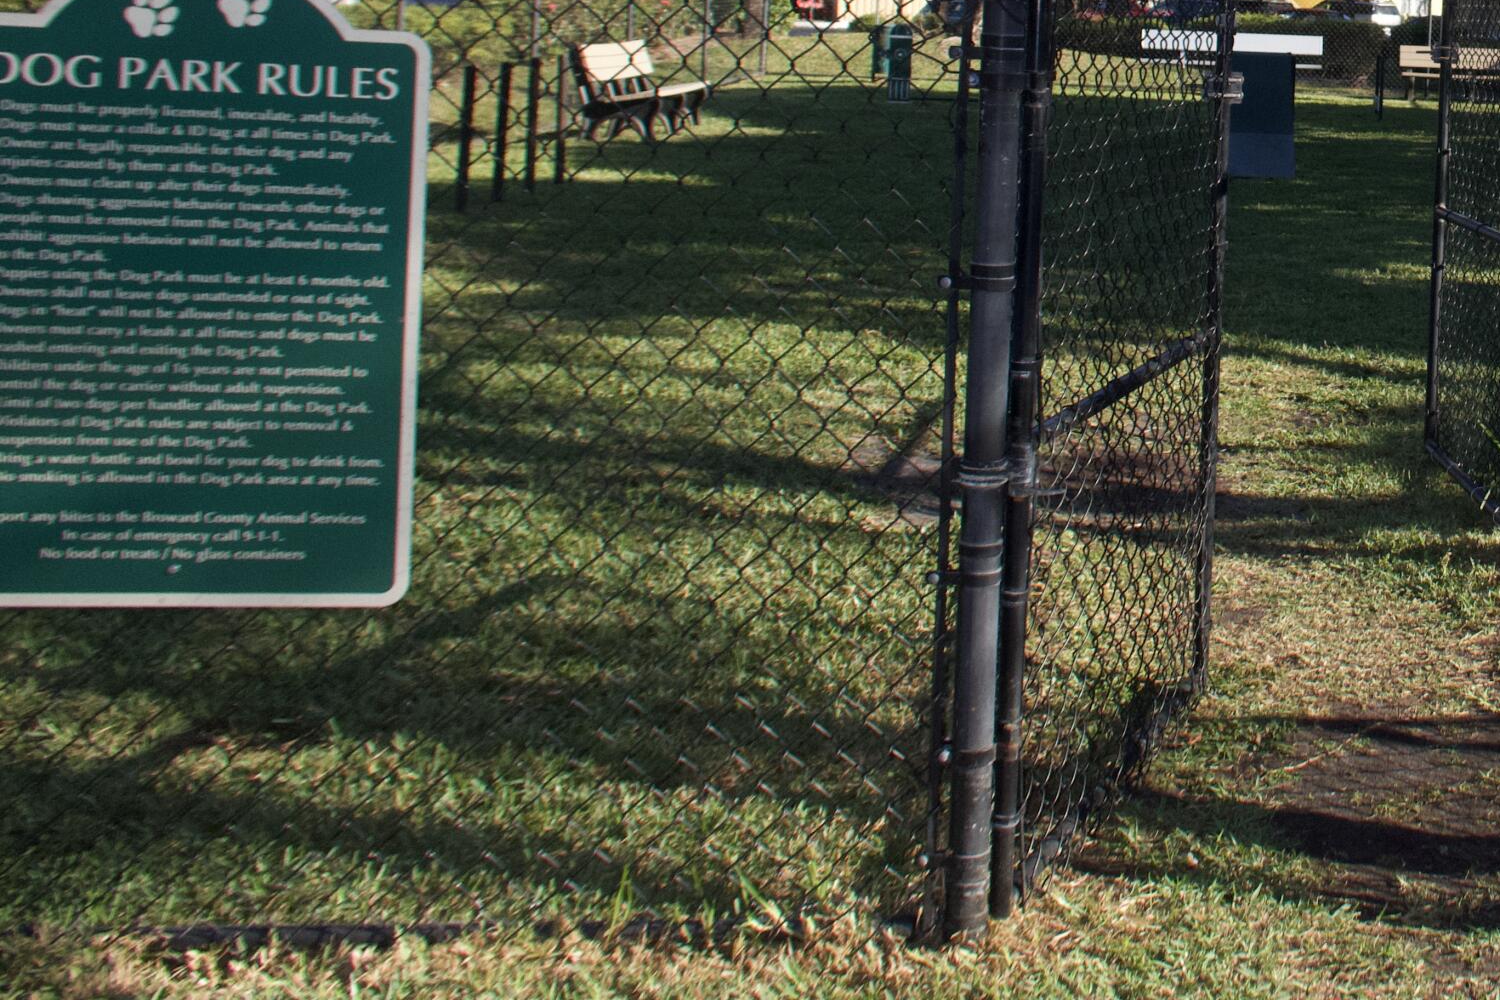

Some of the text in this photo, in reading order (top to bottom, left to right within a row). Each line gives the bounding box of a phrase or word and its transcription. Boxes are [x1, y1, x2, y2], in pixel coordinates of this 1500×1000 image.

[0, 51, 399, 100] DOG PARK RULES
